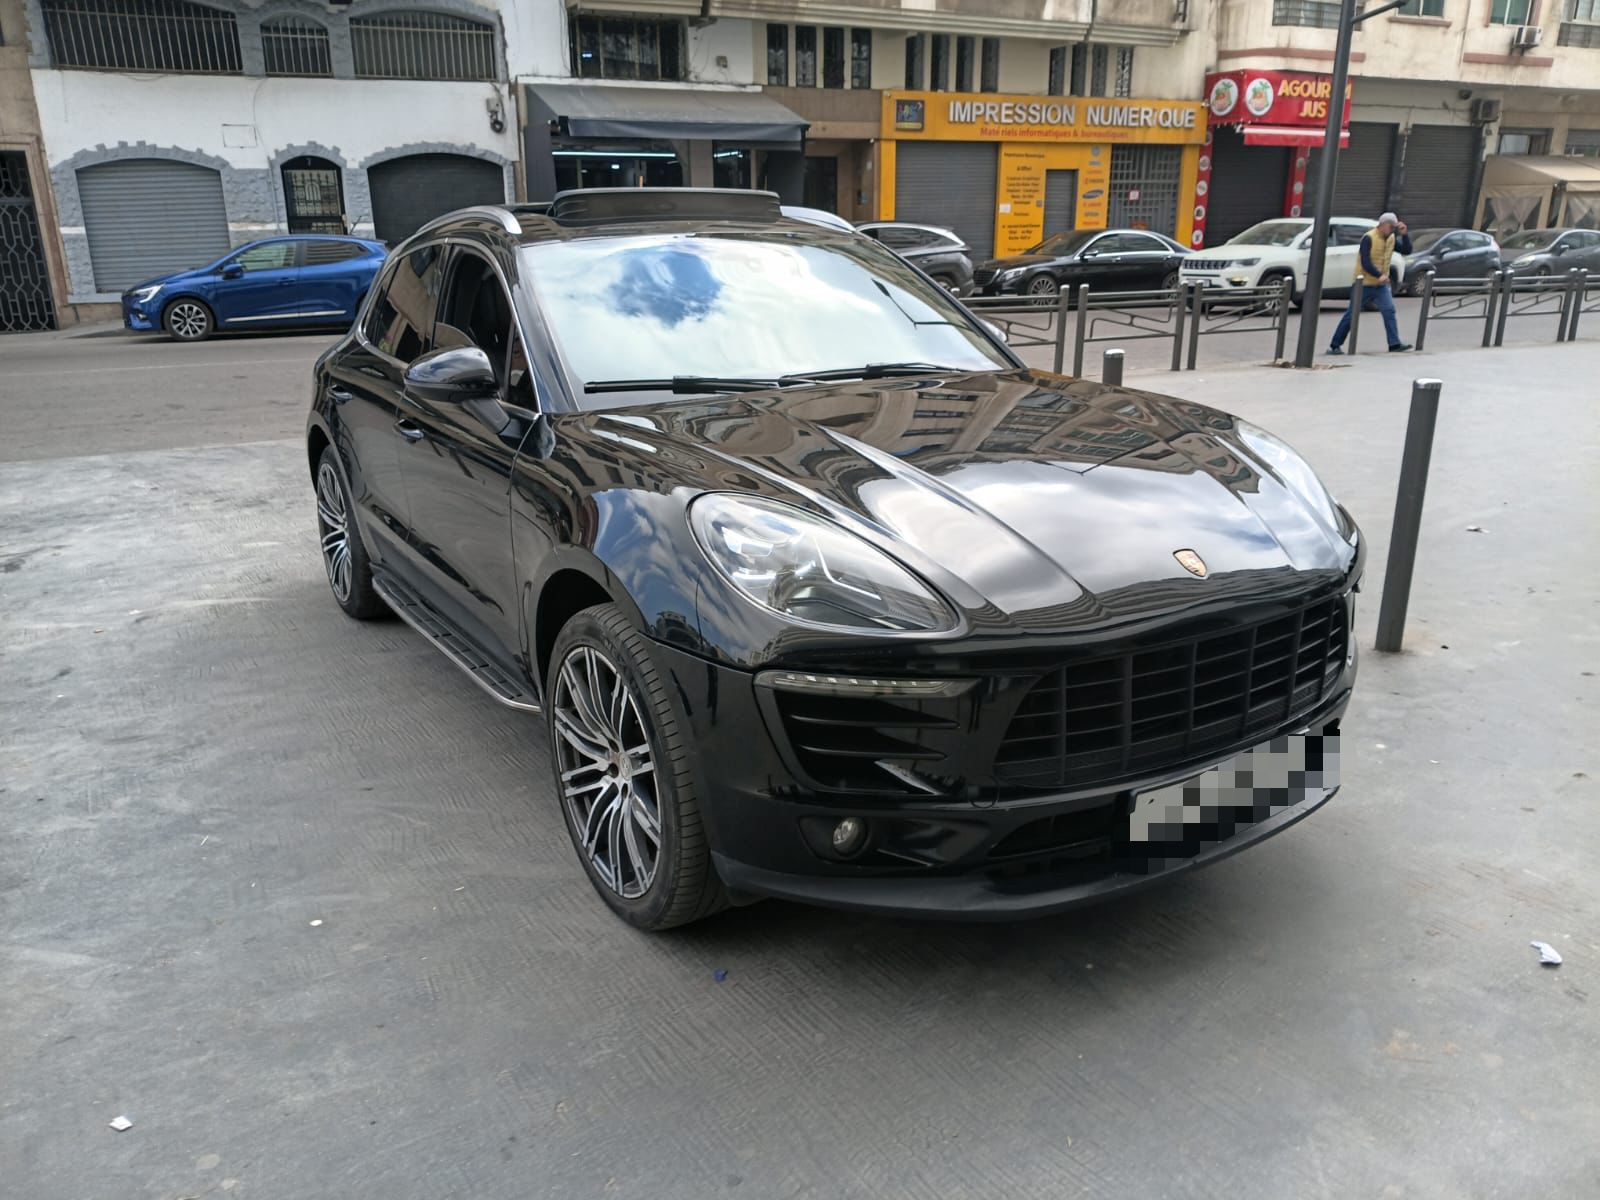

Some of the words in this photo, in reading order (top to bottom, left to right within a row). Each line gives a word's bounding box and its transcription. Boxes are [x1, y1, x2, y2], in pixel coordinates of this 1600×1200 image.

[949, 100, 1076, 125] IMPRESSION
[1086, 104, 1196, 128] NUMERIQUE
[1299, 100, 1327, 118] JUS
